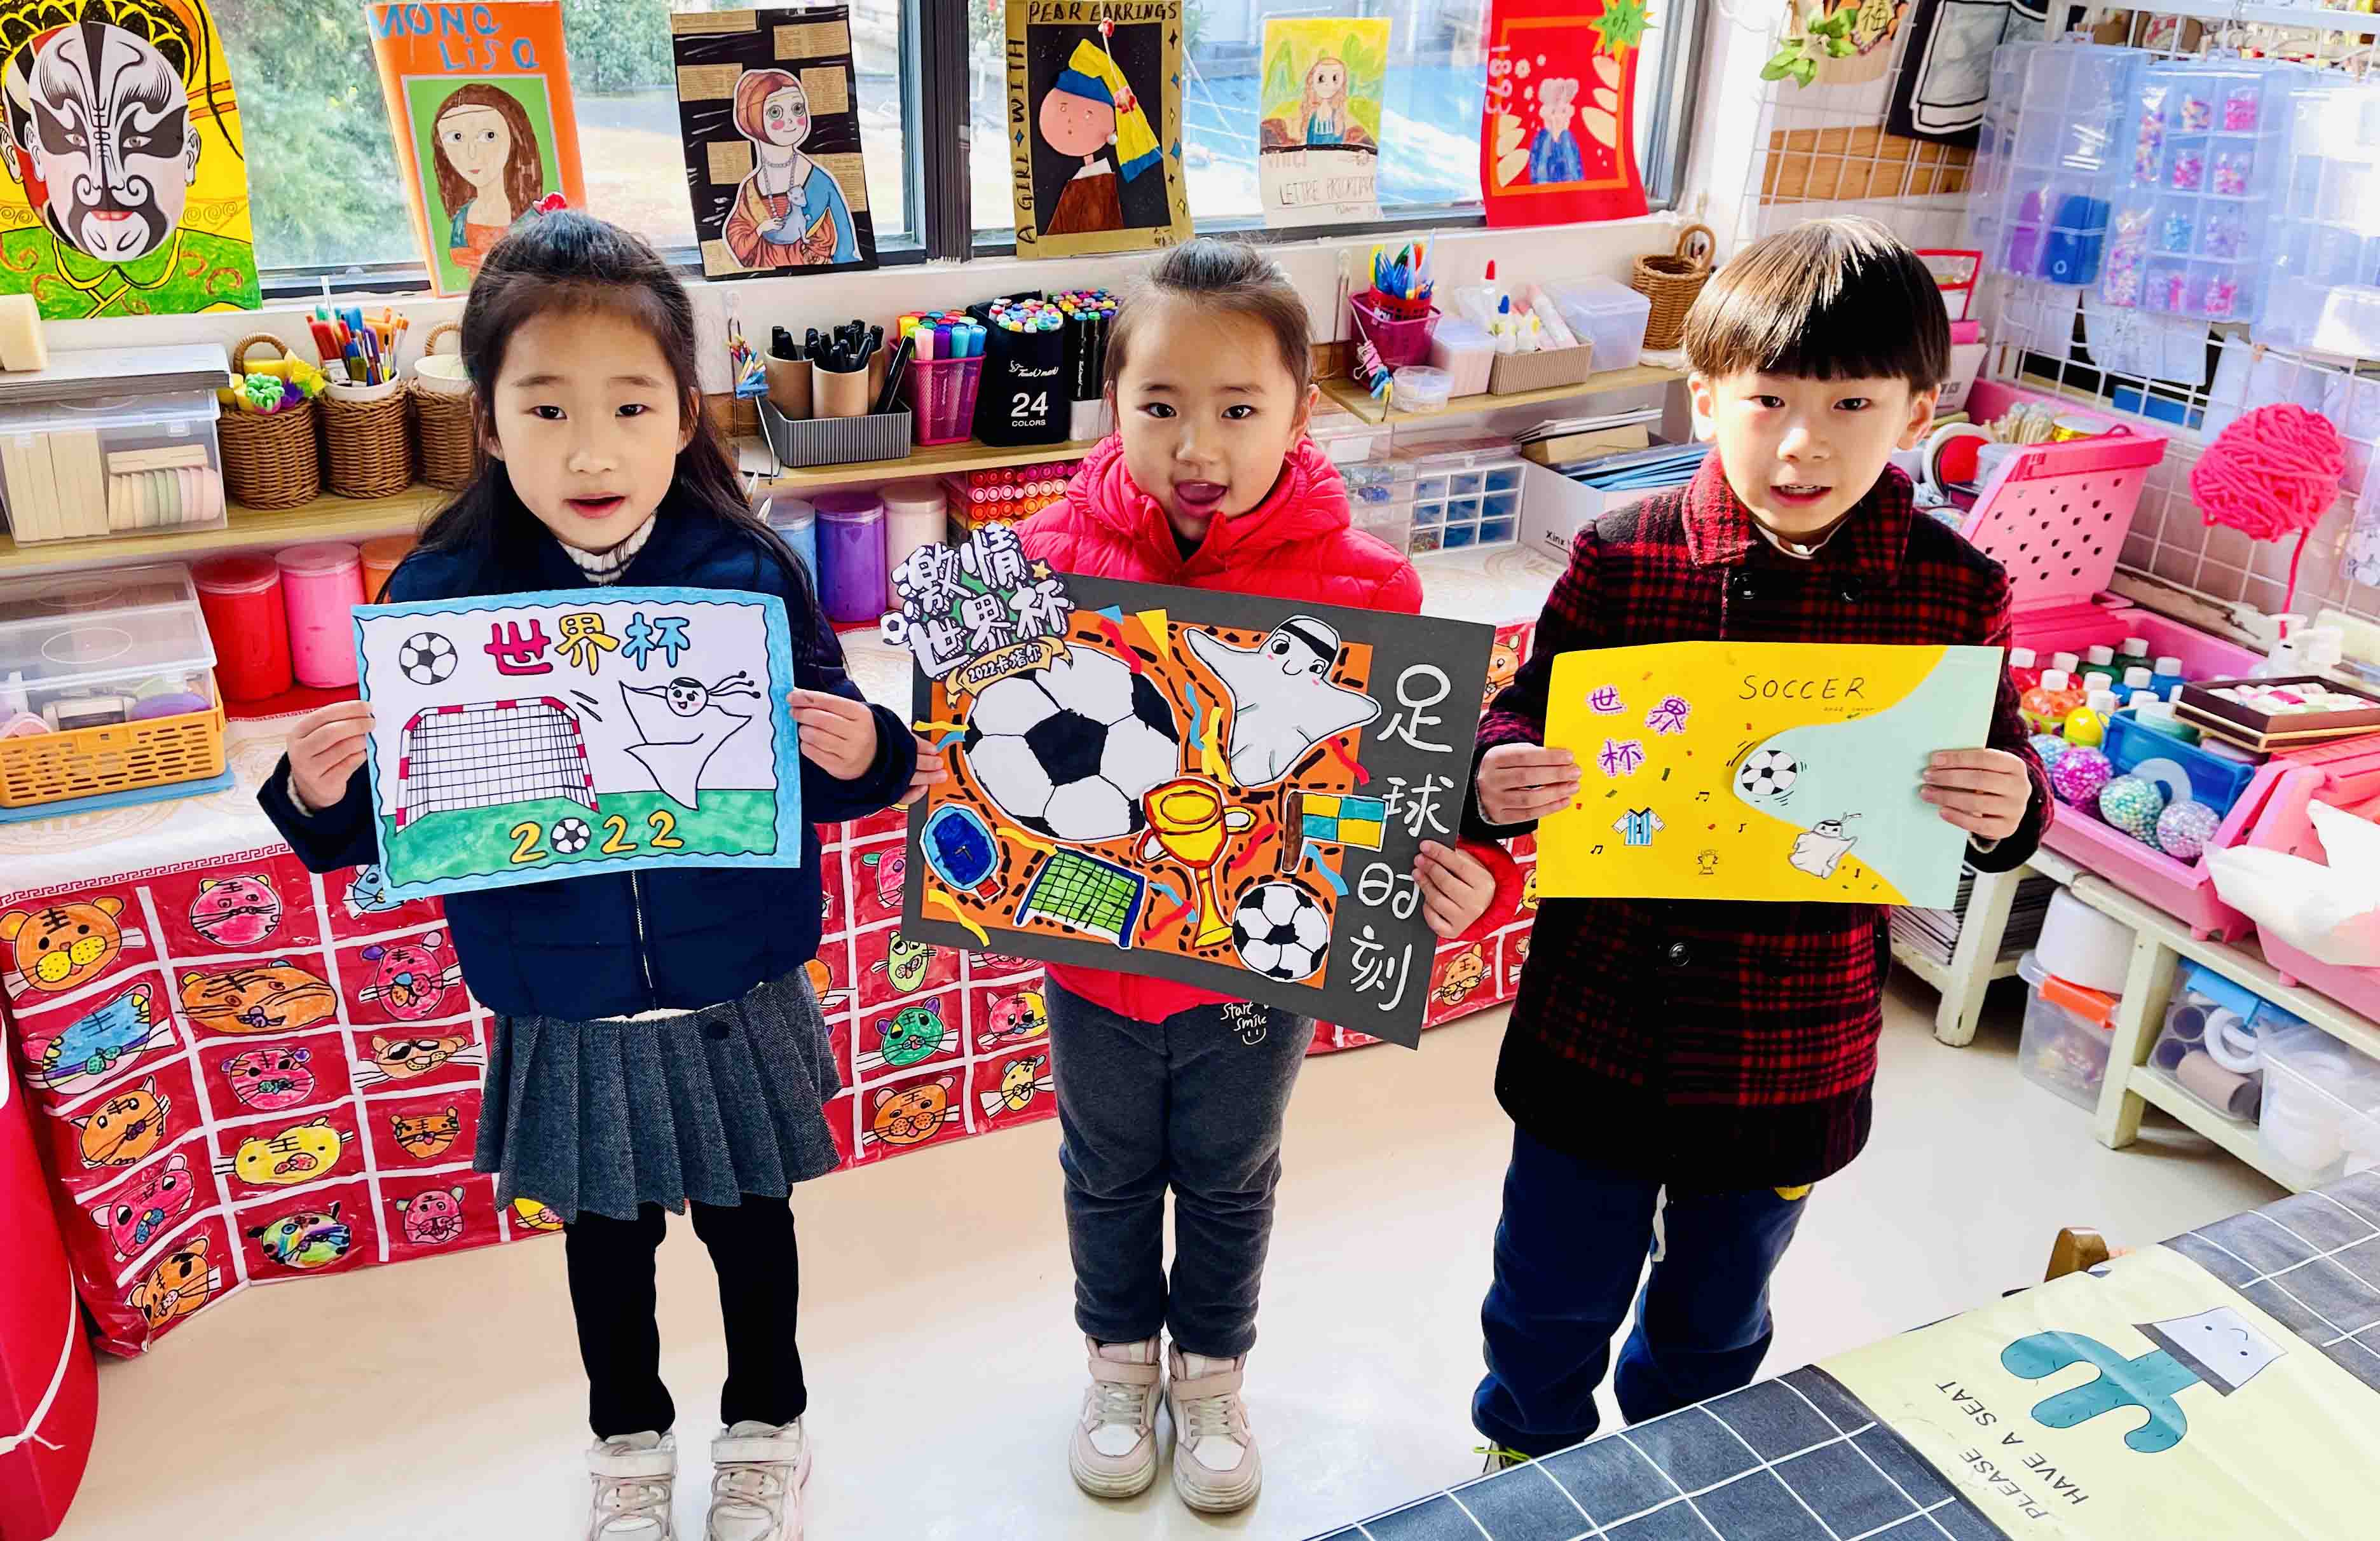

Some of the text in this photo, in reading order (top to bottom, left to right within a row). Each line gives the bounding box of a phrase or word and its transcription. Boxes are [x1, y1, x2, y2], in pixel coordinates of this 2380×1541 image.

[1090, 1, 1178, 22] EARRINGS
[1007, 39, 1036, 245] A GIRL WITH
[1011, 391, 1048, 417] 24
[1011, 419, 1046, 427] COLORS
[891, 524, 1025, 613] 激情
[484, 611, 691, 676] 世界杯
[906, 579, 1074, 678] 世界杯
[968, 644, 1043, 683] 2022卡塔尔
[1739, 675, 1865, 700] SOCCER
[1221, 1002, 1254, 1020] Start
[1233, 1014, 1267, 1031] smile
[1935, 1381, 2089, 1505] HAVE A SEAT
[1959, 1448, 2049, 1519] PLEASE
